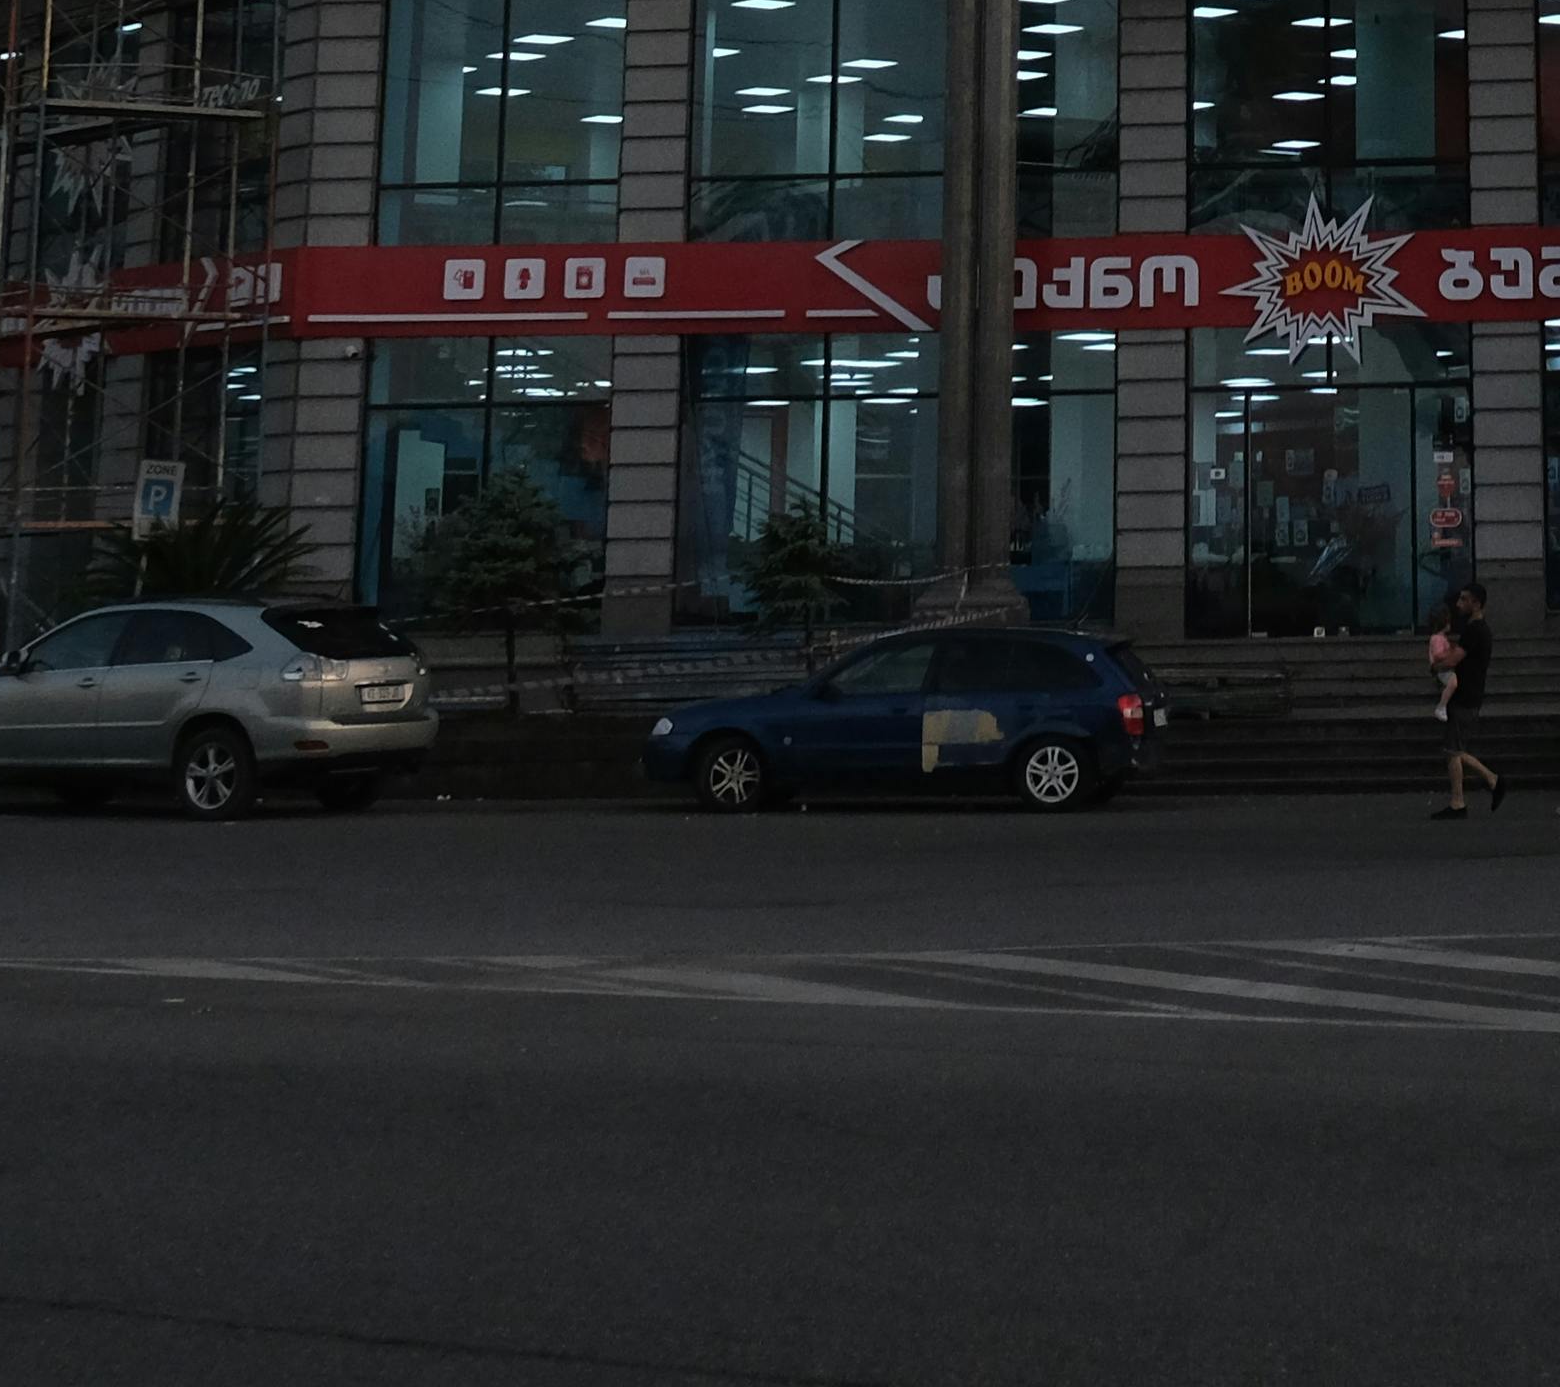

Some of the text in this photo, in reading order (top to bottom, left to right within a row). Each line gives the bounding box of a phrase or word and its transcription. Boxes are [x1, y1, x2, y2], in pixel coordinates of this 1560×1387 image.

[926, 254, 1200, 310] ექნო
[1284, 259, 1366, 297] BOOM
[146, 464, 178, 476] ZONE
[148, 485, 168, 510] P
